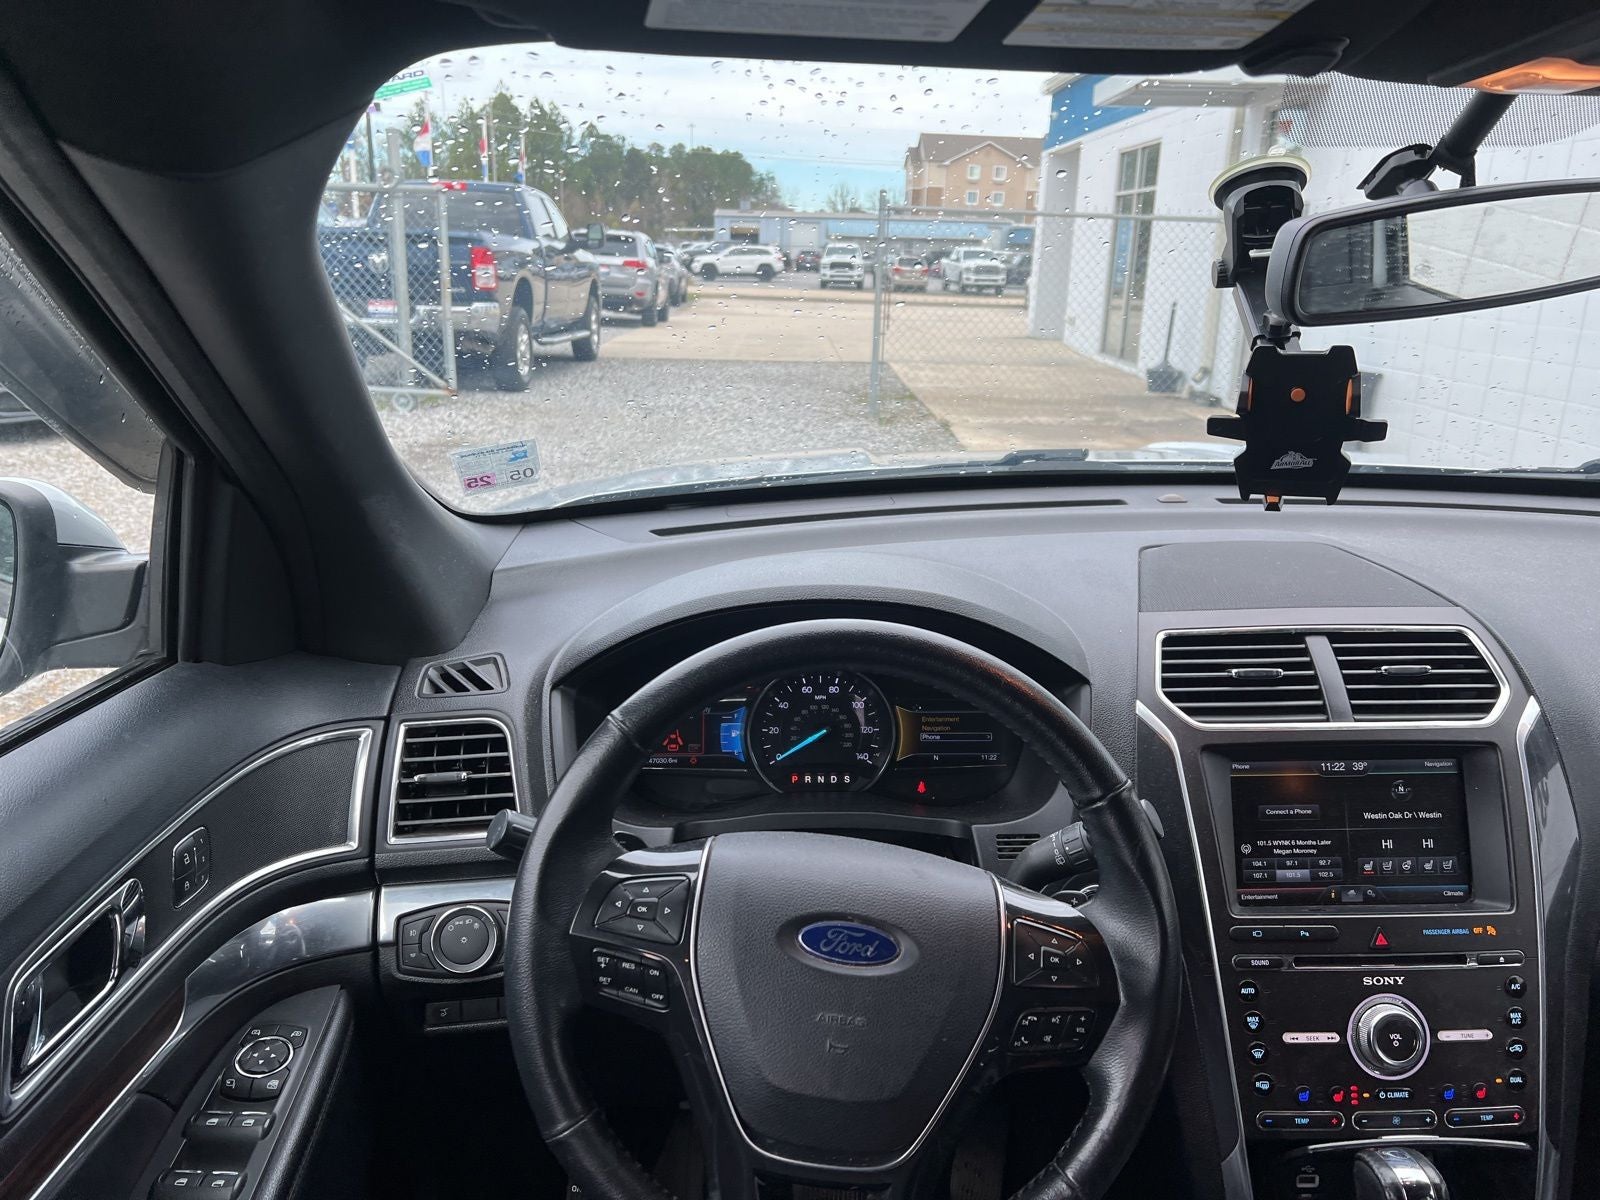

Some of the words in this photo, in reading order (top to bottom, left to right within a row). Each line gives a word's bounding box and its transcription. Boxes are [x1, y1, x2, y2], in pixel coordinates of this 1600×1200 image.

[851, 701, 865, 709] 100
[855, 752, 869, 760] 140
[1321, 762, 1346, 771] 11:22
[791, 775, 798, 783] P
[804, 775, 812, 783] R
[817, 775, 825, 783] N
[830, 775, 837, 783] D
[844, 775, 851, 783] S
[1363, 811, 1387, 819] Westin
[1388, 811, 1403, 819] Oak
[1418, 811, 1442, 819] Westin
[1381, 839, 1393, 849] HI
[1422, 838, 1434, 848] HI
[1422, 928, 1451, 936] PASSENGER
[819, 928, 880, 958] Ford
[1049, 956, 1060, 964] OK
[622, 962, 635, 970] RES
[1362, 975, 1405, 986] SONY
[624, 986, 639, 994] CAN
[1480, 1114, 1494, 1122] TEMP
